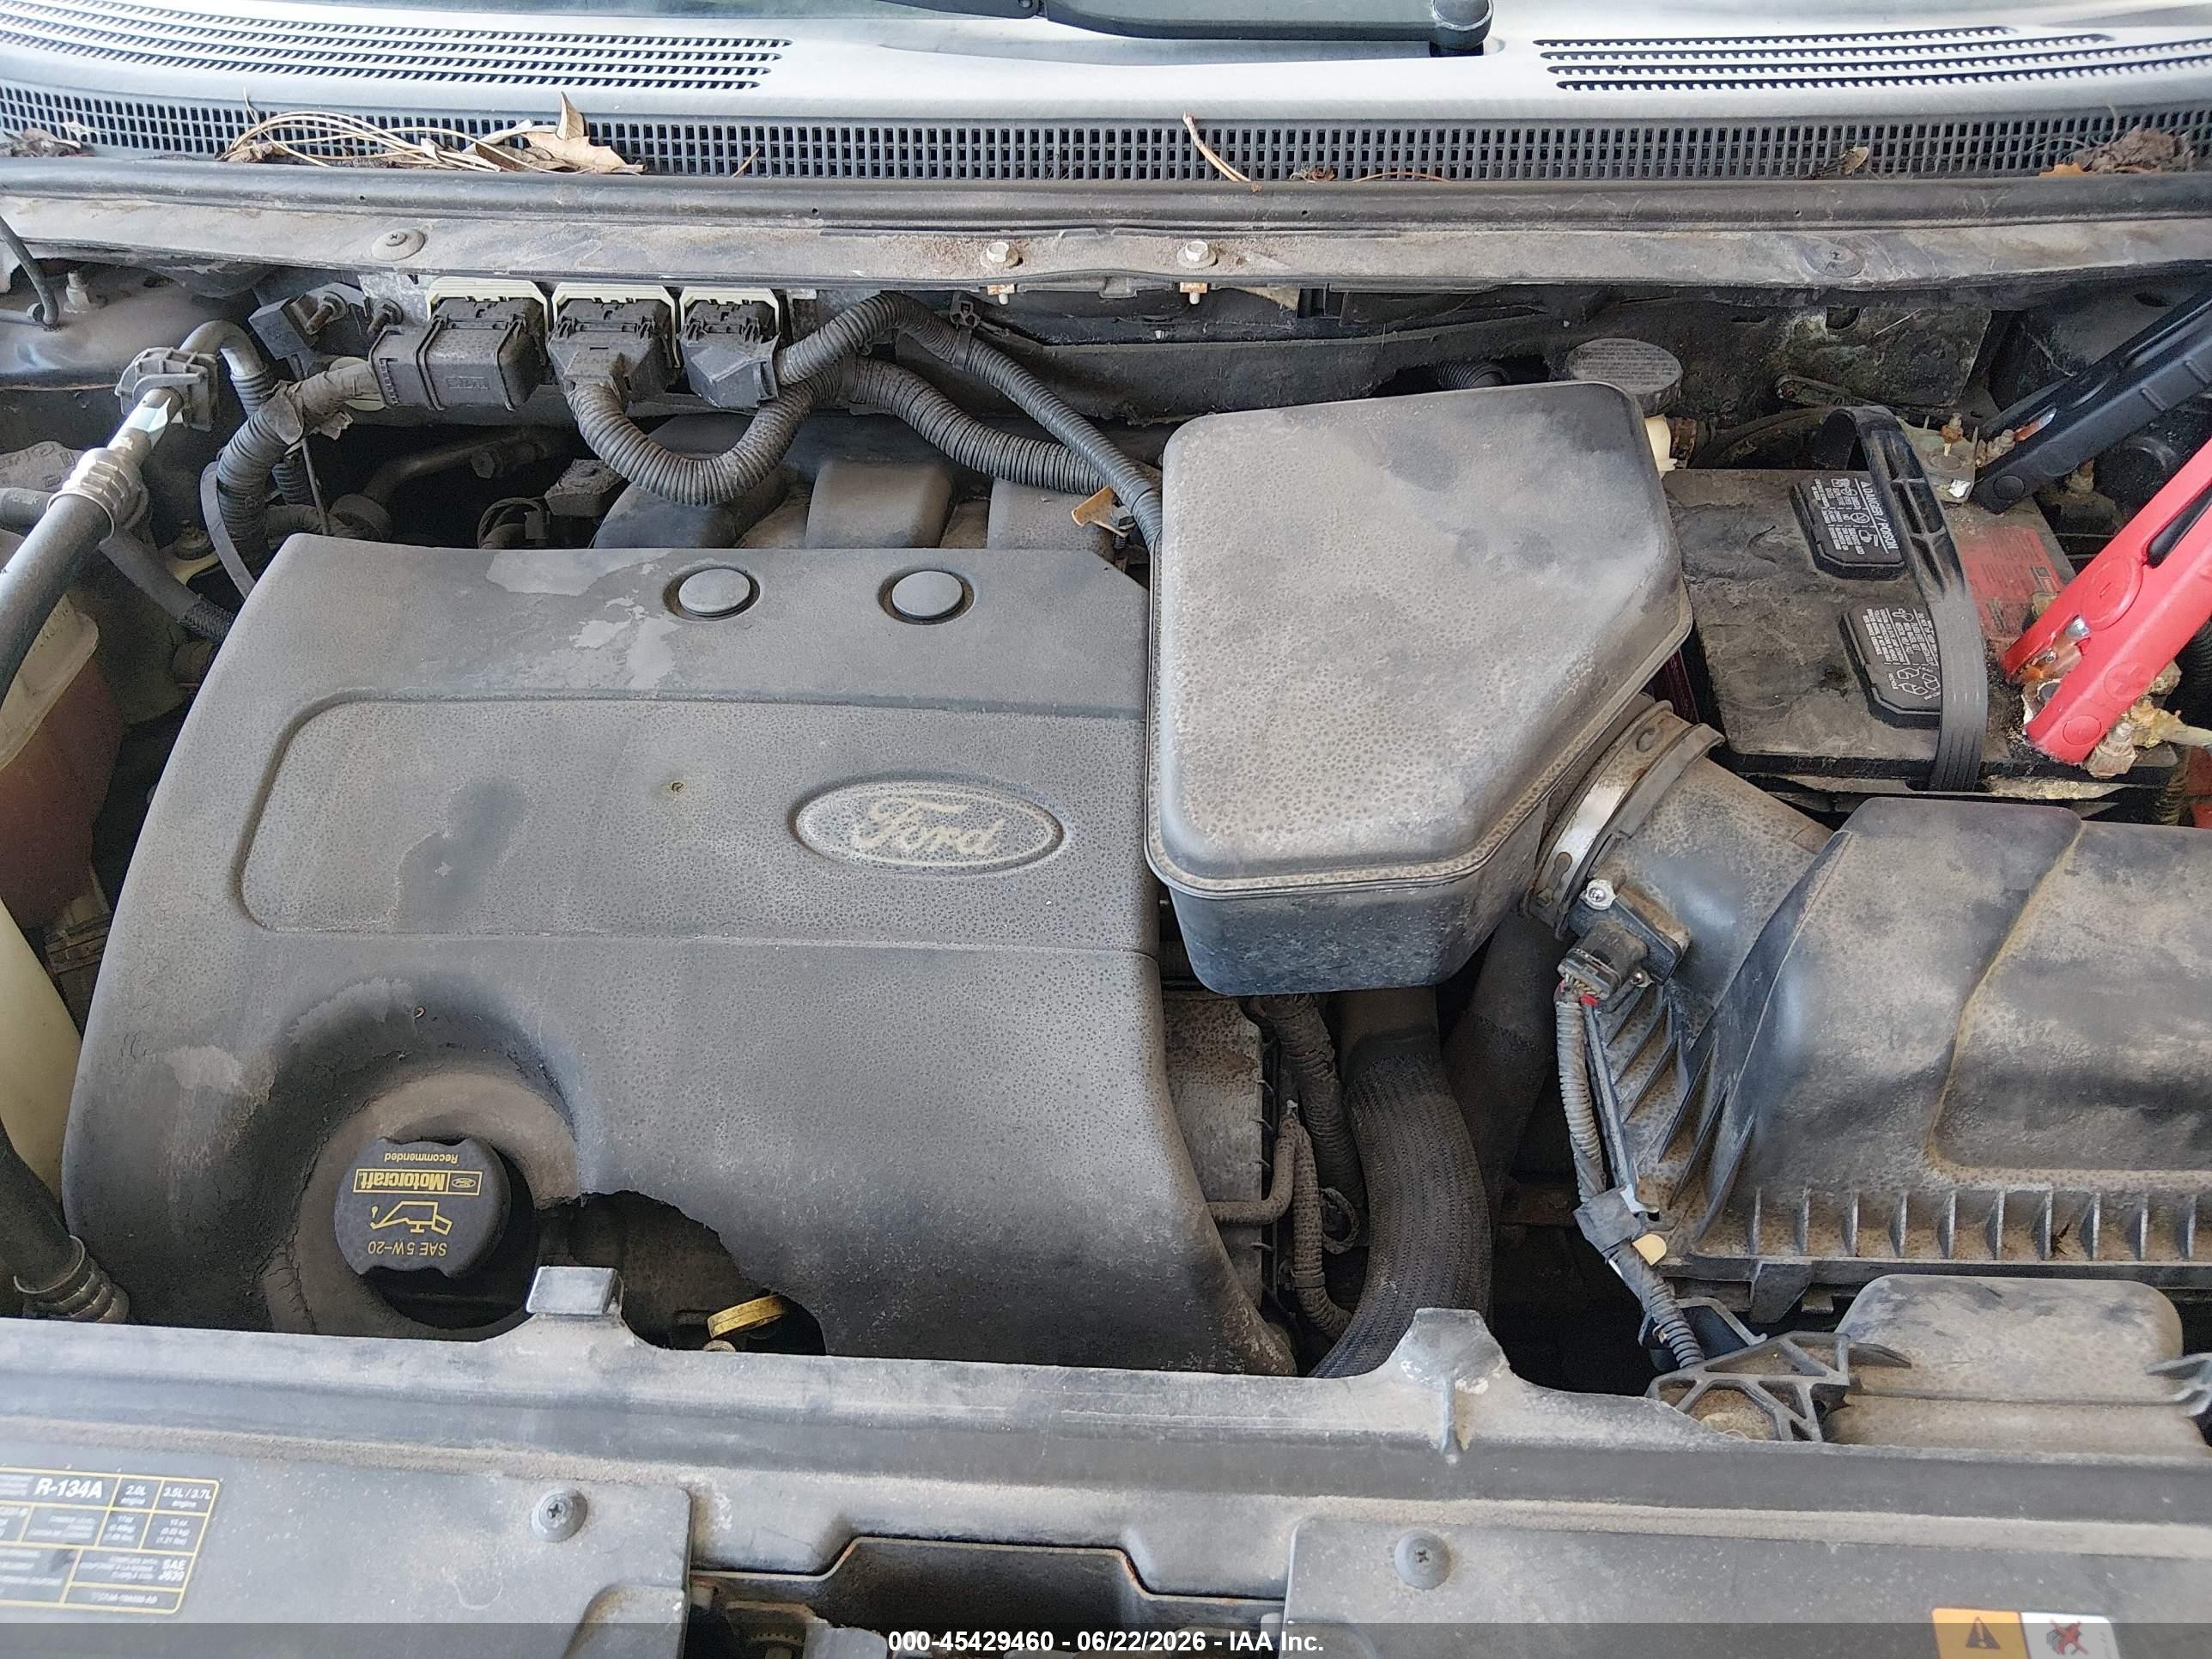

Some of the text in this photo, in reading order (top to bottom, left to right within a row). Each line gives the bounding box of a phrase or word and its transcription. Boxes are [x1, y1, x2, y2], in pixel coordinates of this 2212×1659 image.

[1863, 488, 1884, 516] DANGER
[1877, 522, 1899, 550] POISON
[852, 796, 1006, 854] Ford
[384, 1152, 459, 1164] Recommended
[368, 1240, 447, 1256] SAE 5W-20
[34, 1477, 103, 1499] R-134A
